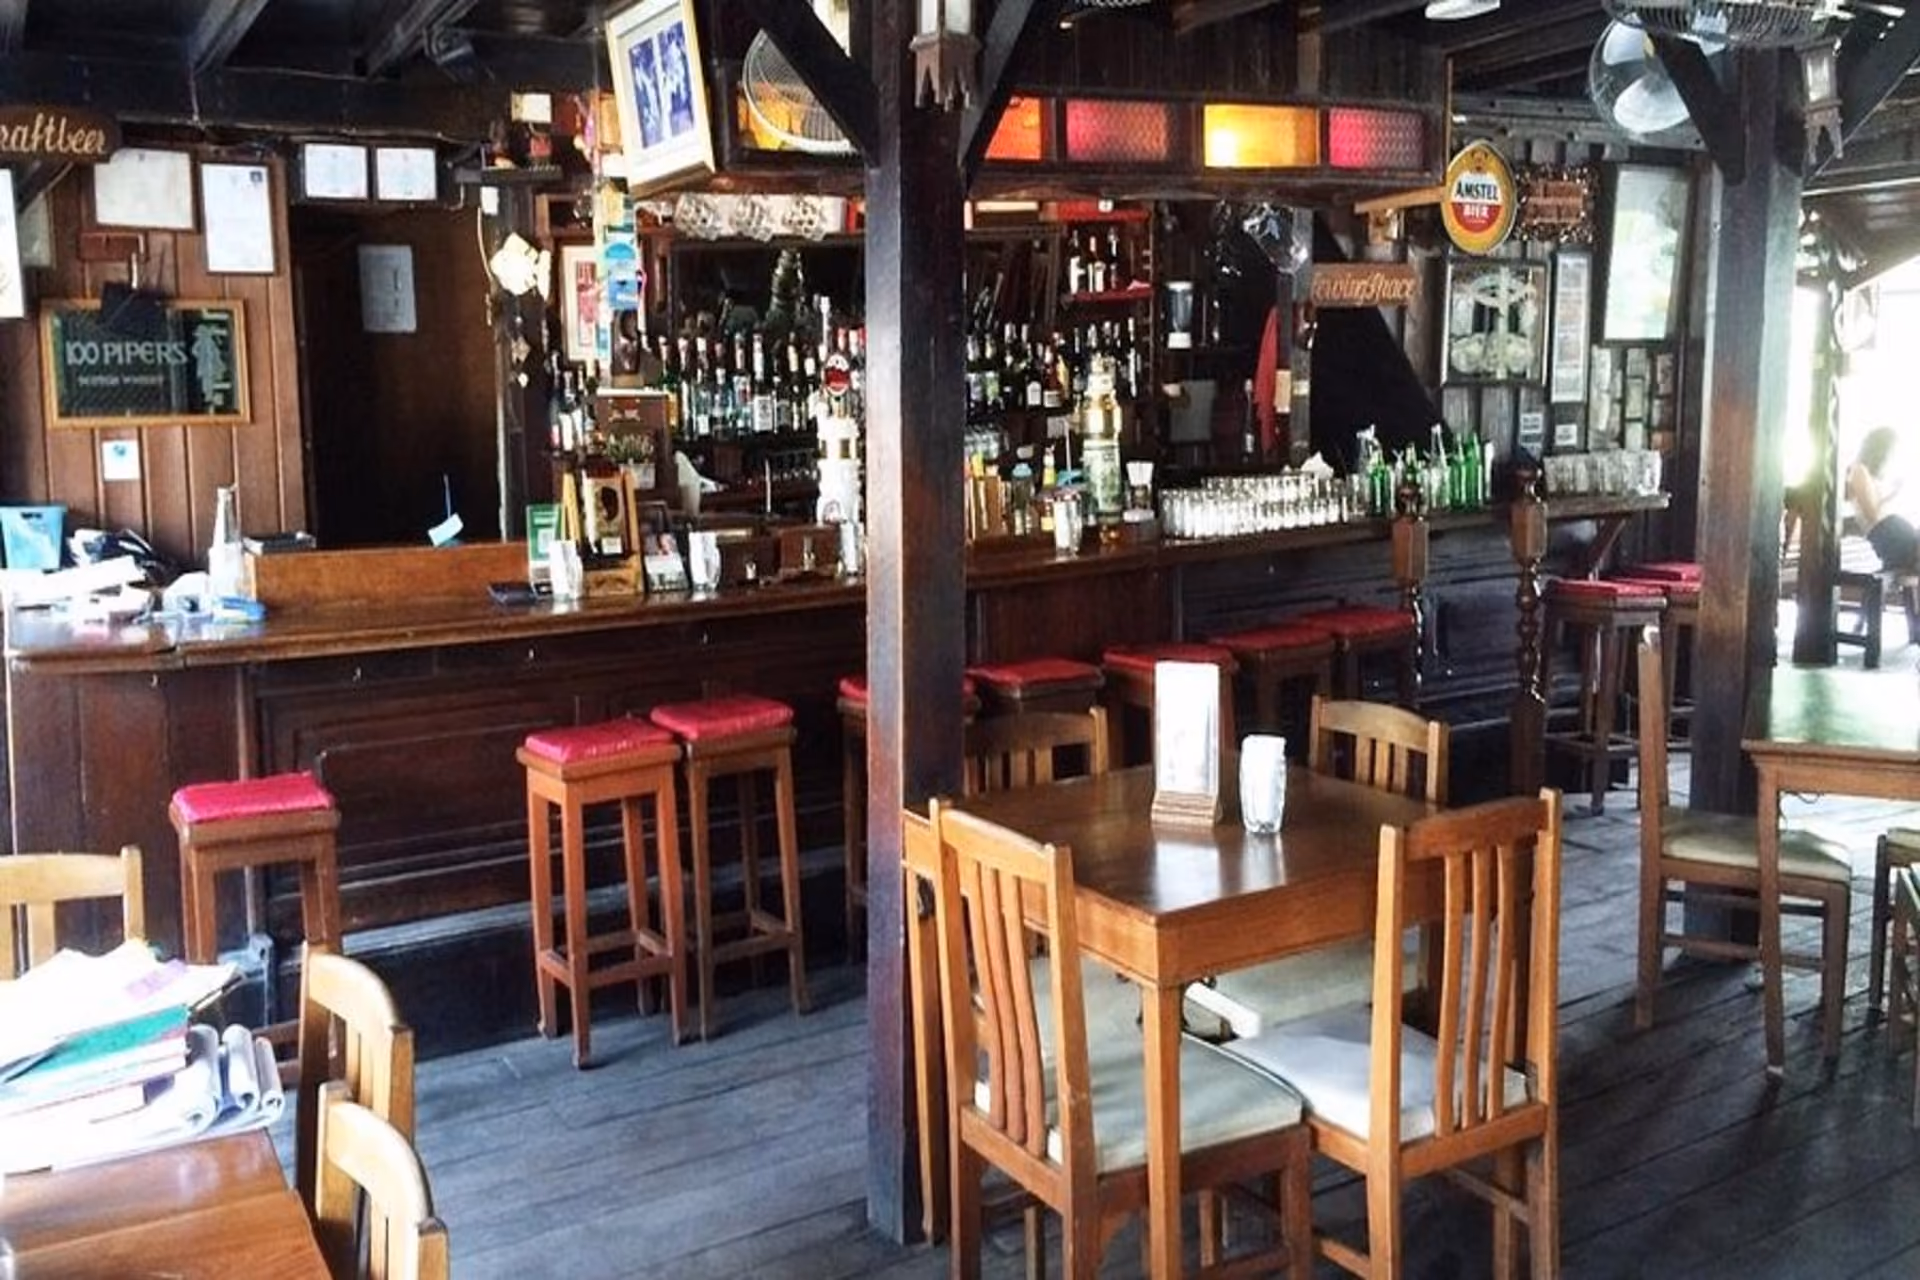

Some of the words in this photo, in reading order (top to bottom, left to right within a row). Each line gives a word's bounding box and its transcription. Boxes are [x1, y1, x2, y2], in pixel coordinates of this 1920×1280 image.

[1455, 181, 1499, 201] AMSTEL
[1463, 204, 1490, 219] BIER
[66, 341, 99, 365] 100
[103, 341, 187, 364] PIPERS
